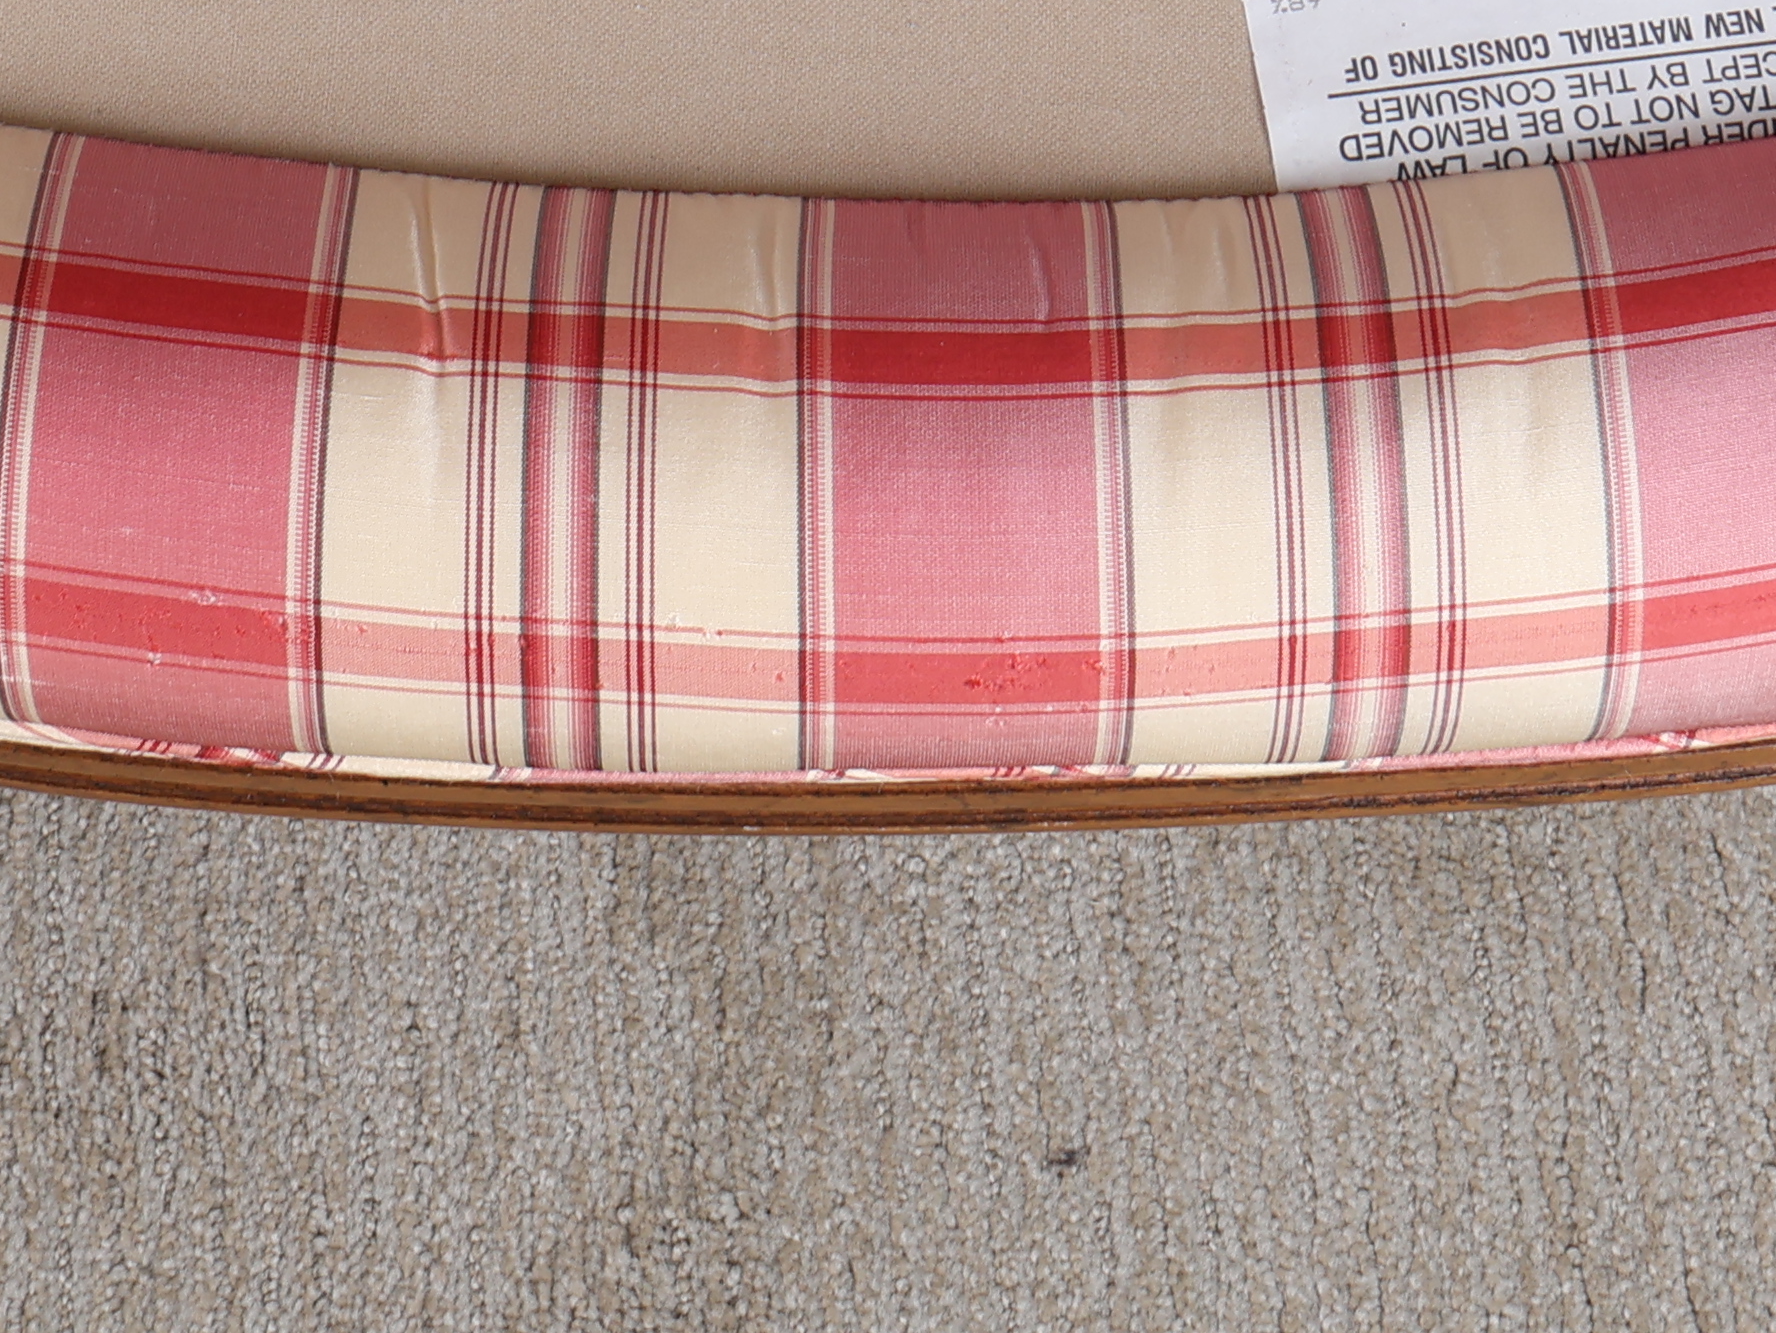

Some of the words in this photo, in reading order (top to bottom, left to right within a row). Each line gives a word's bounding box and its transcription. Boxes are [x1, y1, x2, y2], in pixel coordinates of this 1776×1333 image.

[1558, 16, 1694, 55] MATERIAL
[1704, 7, 1766, 39] NEW
[1344, 55, 1379, 84] OF
[1387, 33, 1551, 78] CONSISTING
[1564, 68, 1637, 100] THE
[1647, 61, 1690, 91] BY
[1357, 77, 1556, 125] CONSUMER
[1574, 102, 1622, 131] TO
[1630, 92, 1700, 125] NOT
[1338, 115, 1509, 162] REMOVED
[1517, 108, 1564, 138] BE
[1393, 152, 1468, 183] LAW
